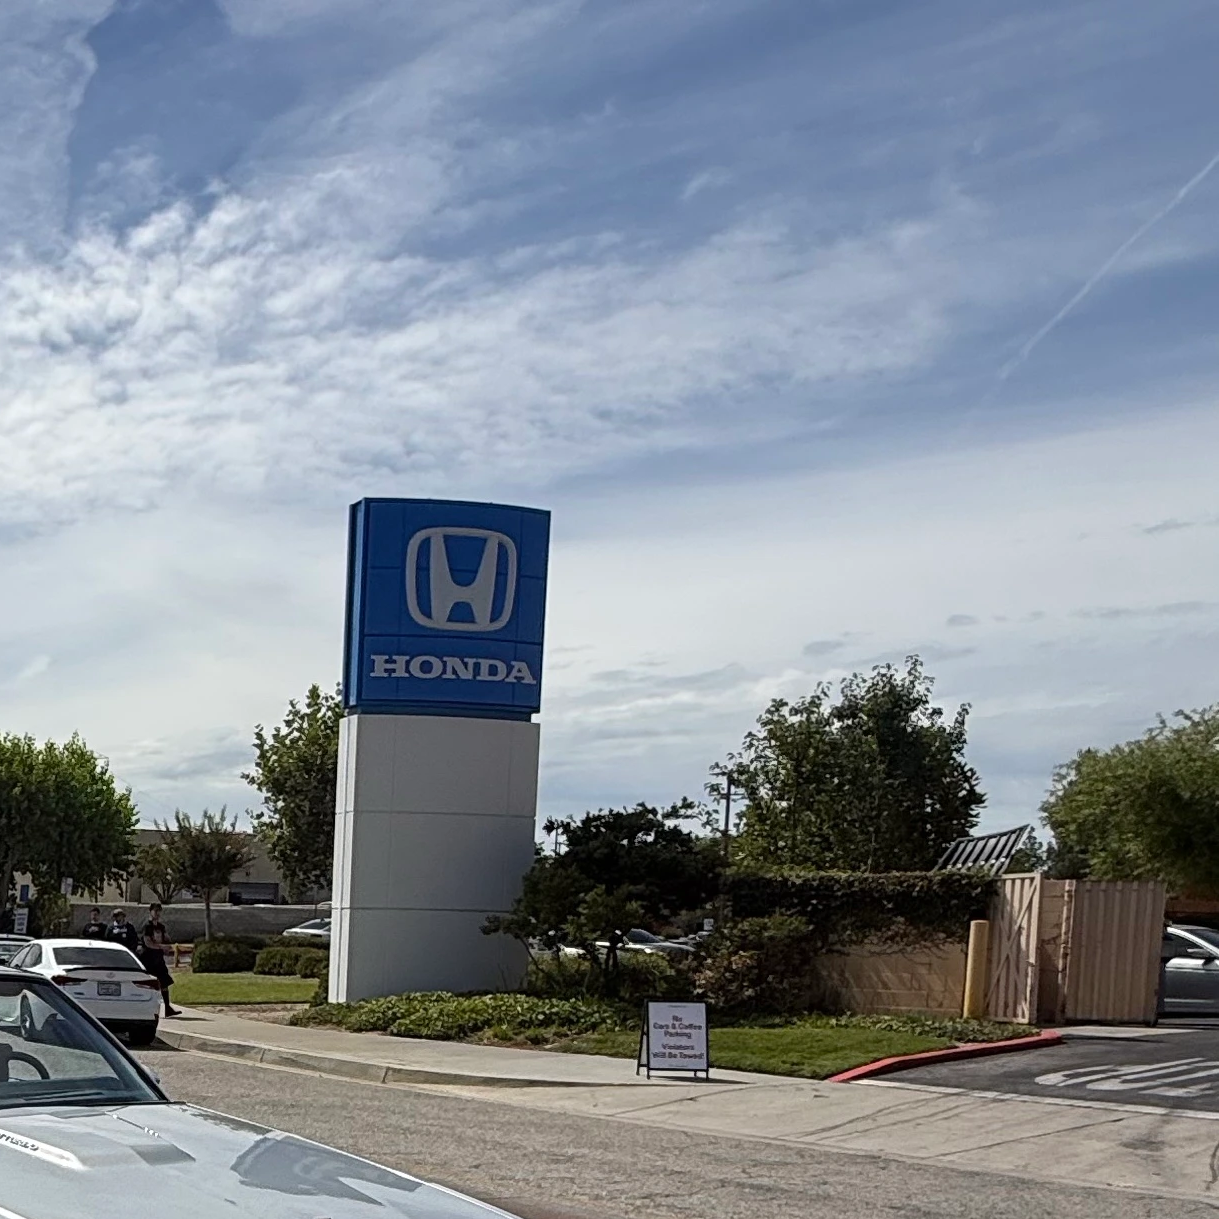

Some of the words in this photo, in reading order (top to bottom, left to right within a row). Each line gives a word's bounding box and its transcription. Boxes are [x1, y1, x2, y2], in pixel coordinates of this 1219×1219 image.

[369, 654, 537, 685] HONDA
[653, 1022, 669, 1030] Cars
[678, 1022, 703, 1030] Coffee
[663, 1030, 693, 1039] Parking
